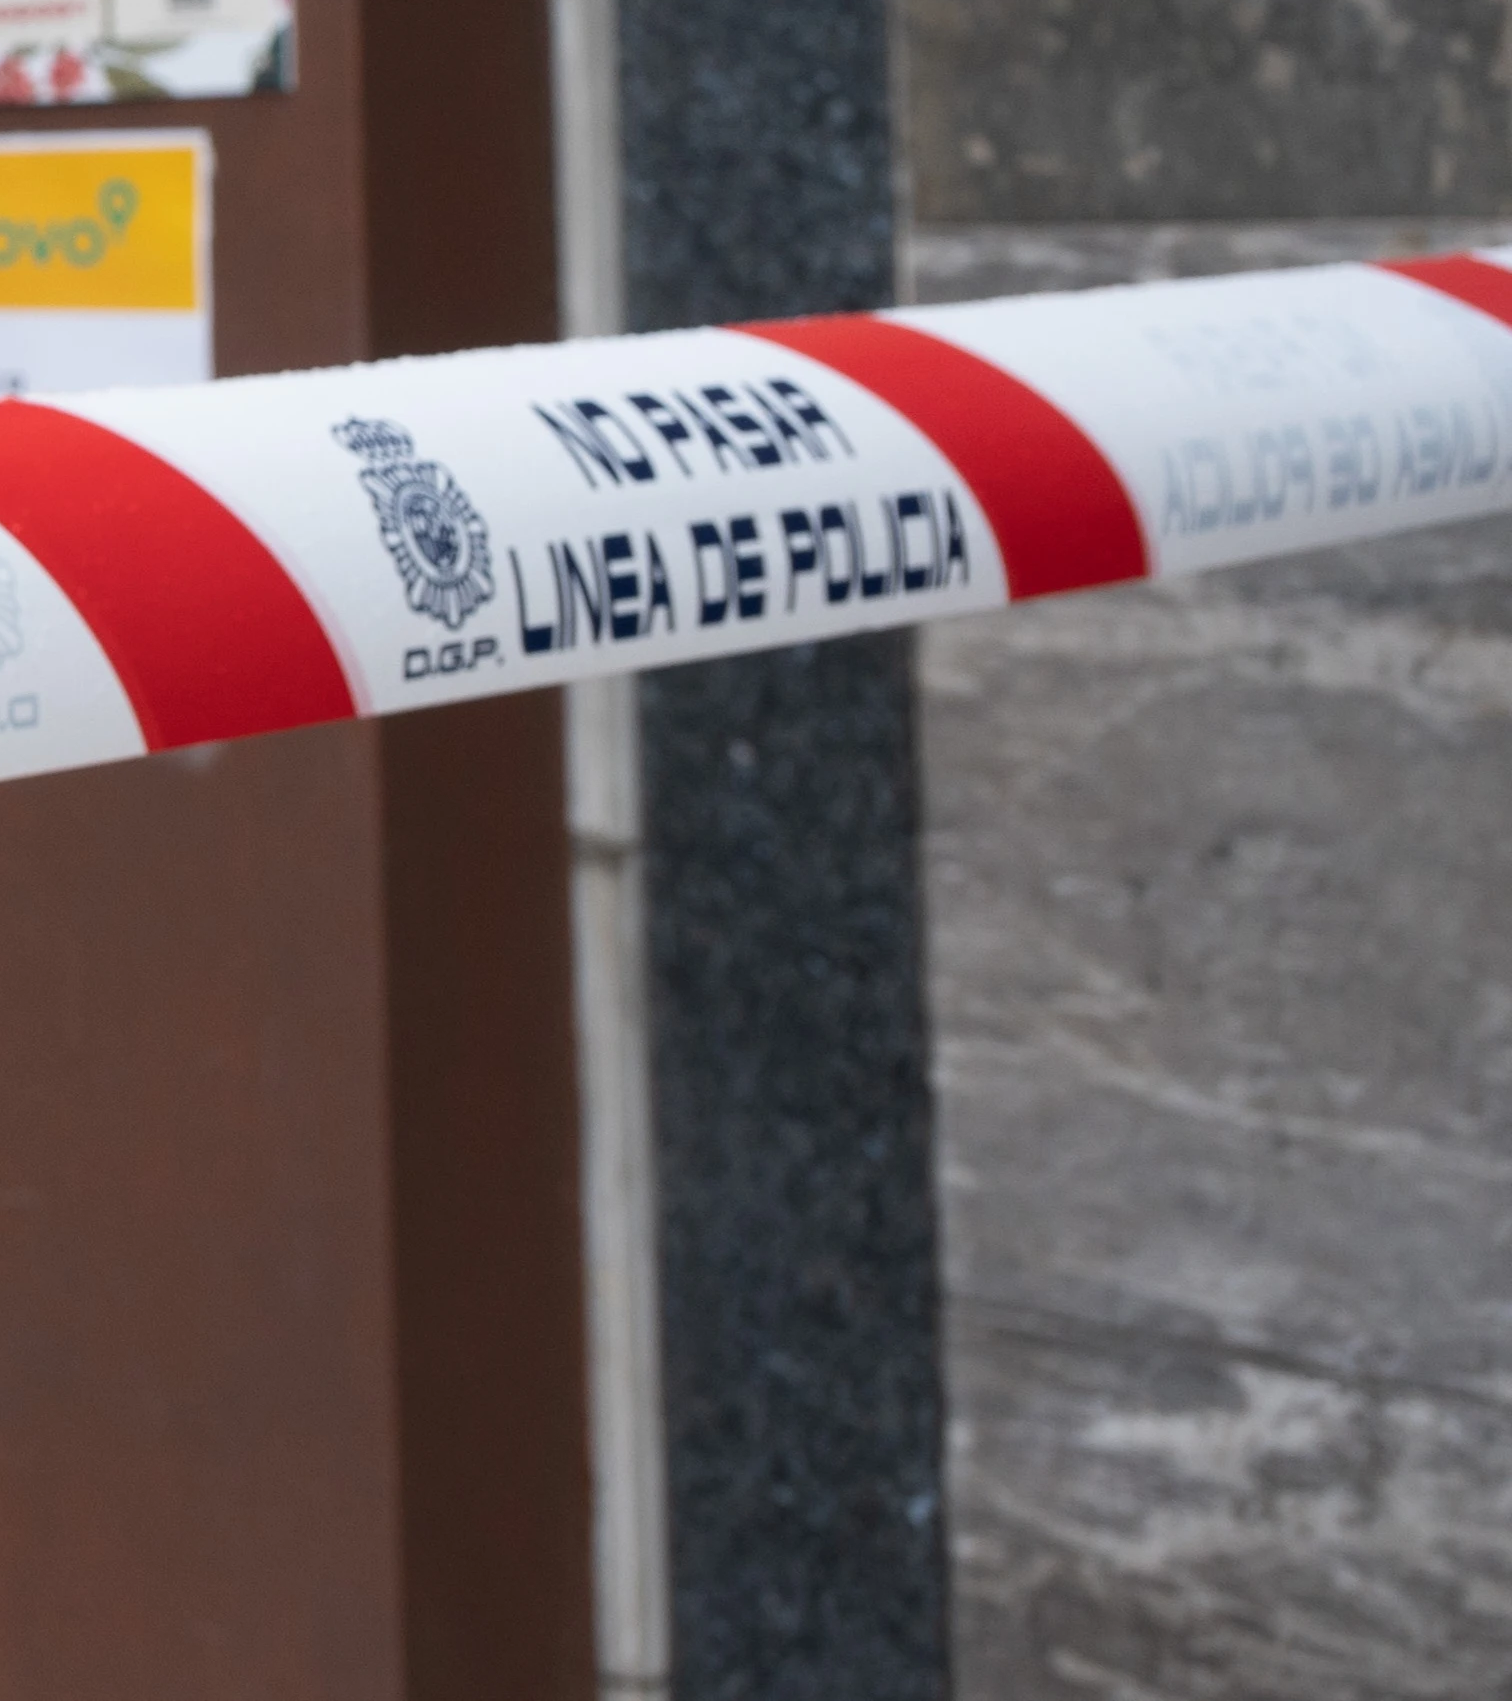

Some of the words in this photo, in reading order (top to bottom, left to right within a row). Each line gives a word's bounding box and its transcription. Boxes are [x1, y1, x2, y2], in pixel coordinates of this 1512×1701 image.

[533, 399, 656, 490] NO
[623, 377, 856, 477] PASAR
[508, 530, 675, 654] LINEA
[689, 514, 766, 627] DE
[779, 488, 970, 611] POLICIA
[403, 635, 505, 681] D.G.P.
